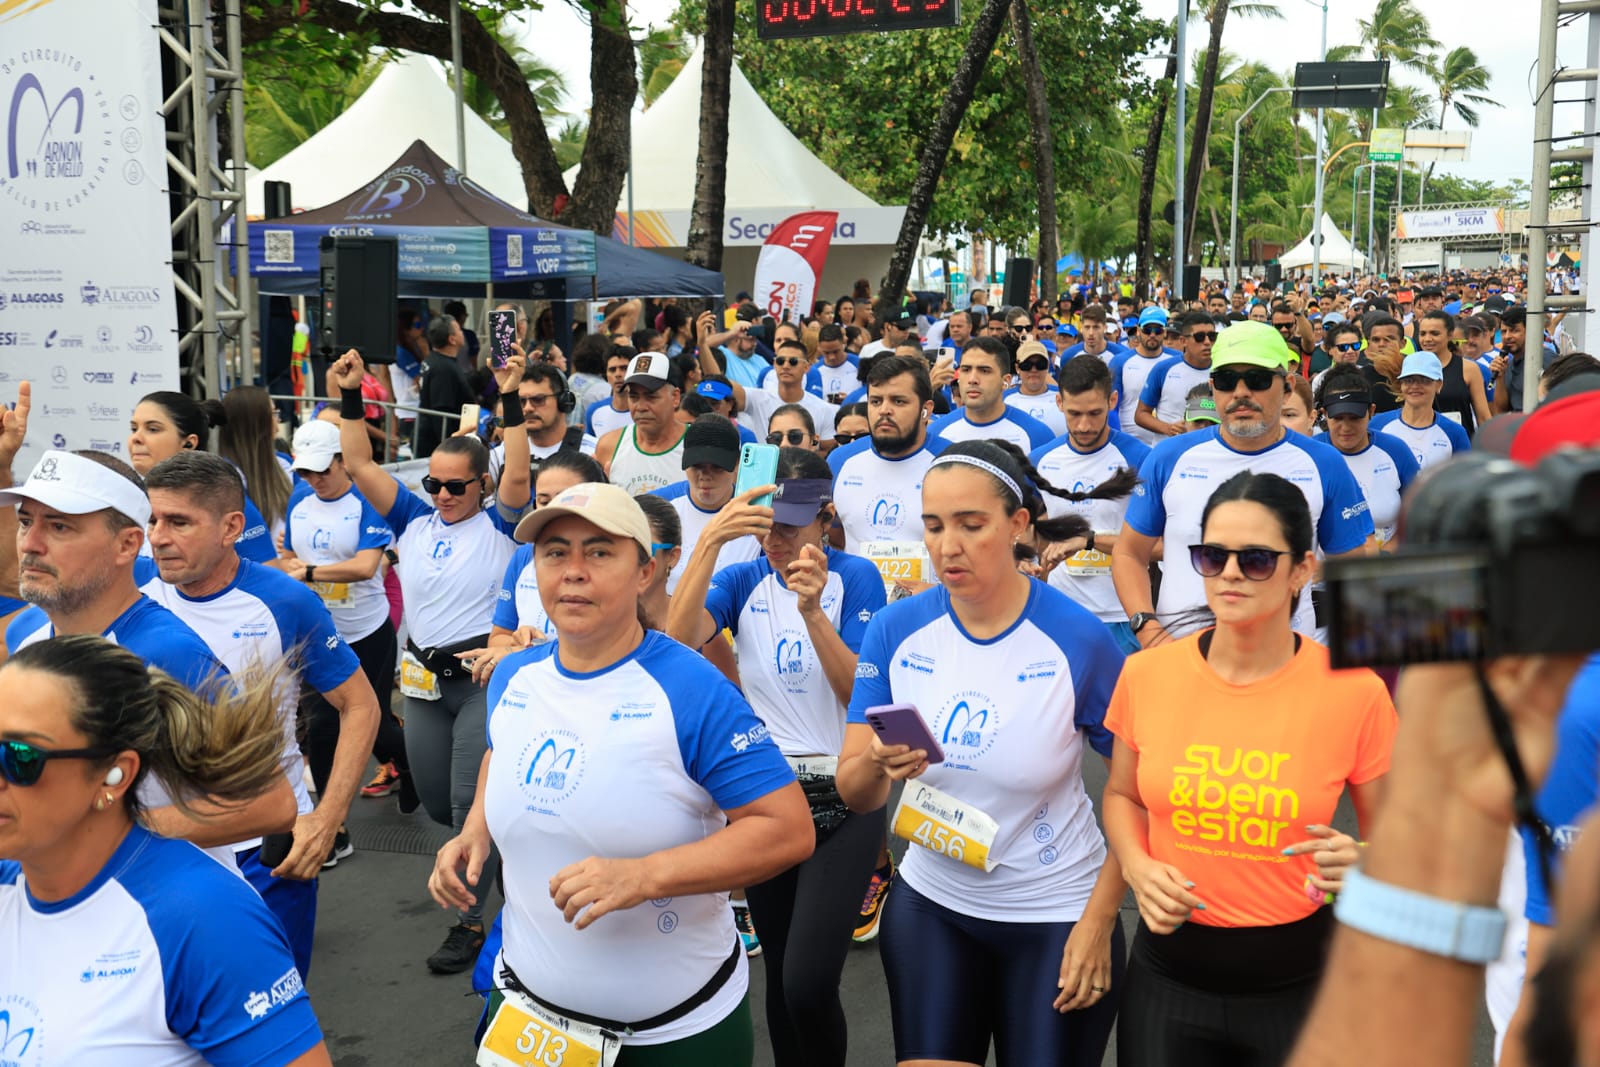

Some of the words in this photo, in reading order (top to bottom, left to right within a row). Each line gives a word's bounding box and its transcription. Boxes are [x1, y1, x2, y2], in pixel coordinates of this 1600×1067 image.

[11, 293, 64, 303] ALAGOAS
[876, 560, 912, 578] 422
[1173, 744, 1291, 782] suor
[1168, 773, 1299, 819] &bem
[912, 819, 966, 861] 456
[1171, 808, 1290, 847] estar
[515, 1020, 568, 1067] 513
